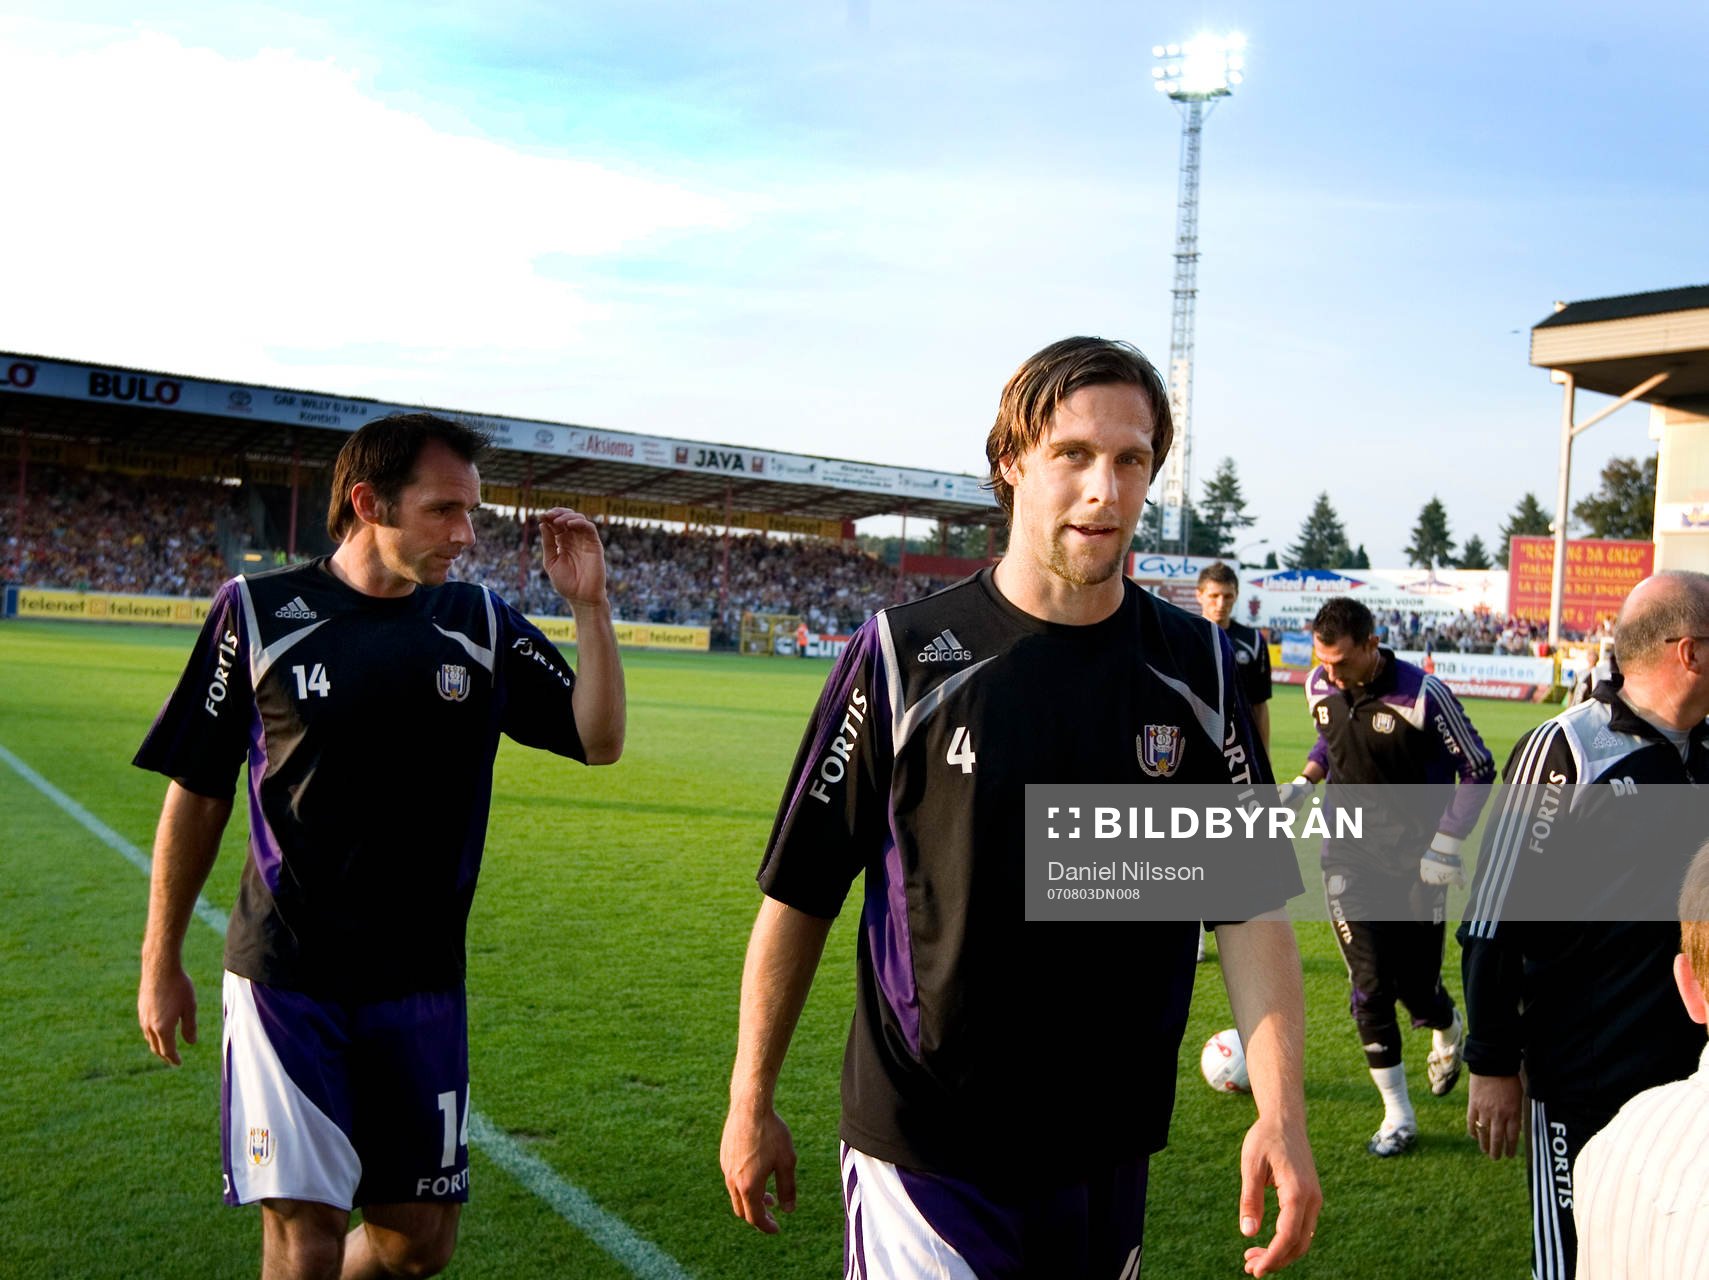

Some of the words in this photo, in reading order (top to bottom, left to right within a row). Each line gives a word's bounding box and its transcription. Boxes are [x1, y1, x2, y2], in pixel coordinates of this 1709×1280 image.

[89, 371, 181, 405] BULO
[586, 433, 635, 458] Aksioma
[694, 450, 745, 471] JAVA
[606, 500, 666, 518] telenet
[768, 517, 823, 533] telenet
[21, 596, 86, 614] telenet
[110, 602, 172, 618] telenet
[275, 610, 318, 620] adidas
[649, 630, 694, 645] telenet
[917, 649, 973, 663] adidas
[204, 629, 239, 718] FORTIS
[292, 663, 331, 699] 14
[808, 687, 868, 804] FORTIS
[1434, 714, 1460, 754] FORTIS
[946, 726, 977, 774] 4
[1609, 776, 1638, 797] DR
[1528, 770, 1567, 854] FORTIS
[1550, 1121, 1574, 1210] FORTIS
